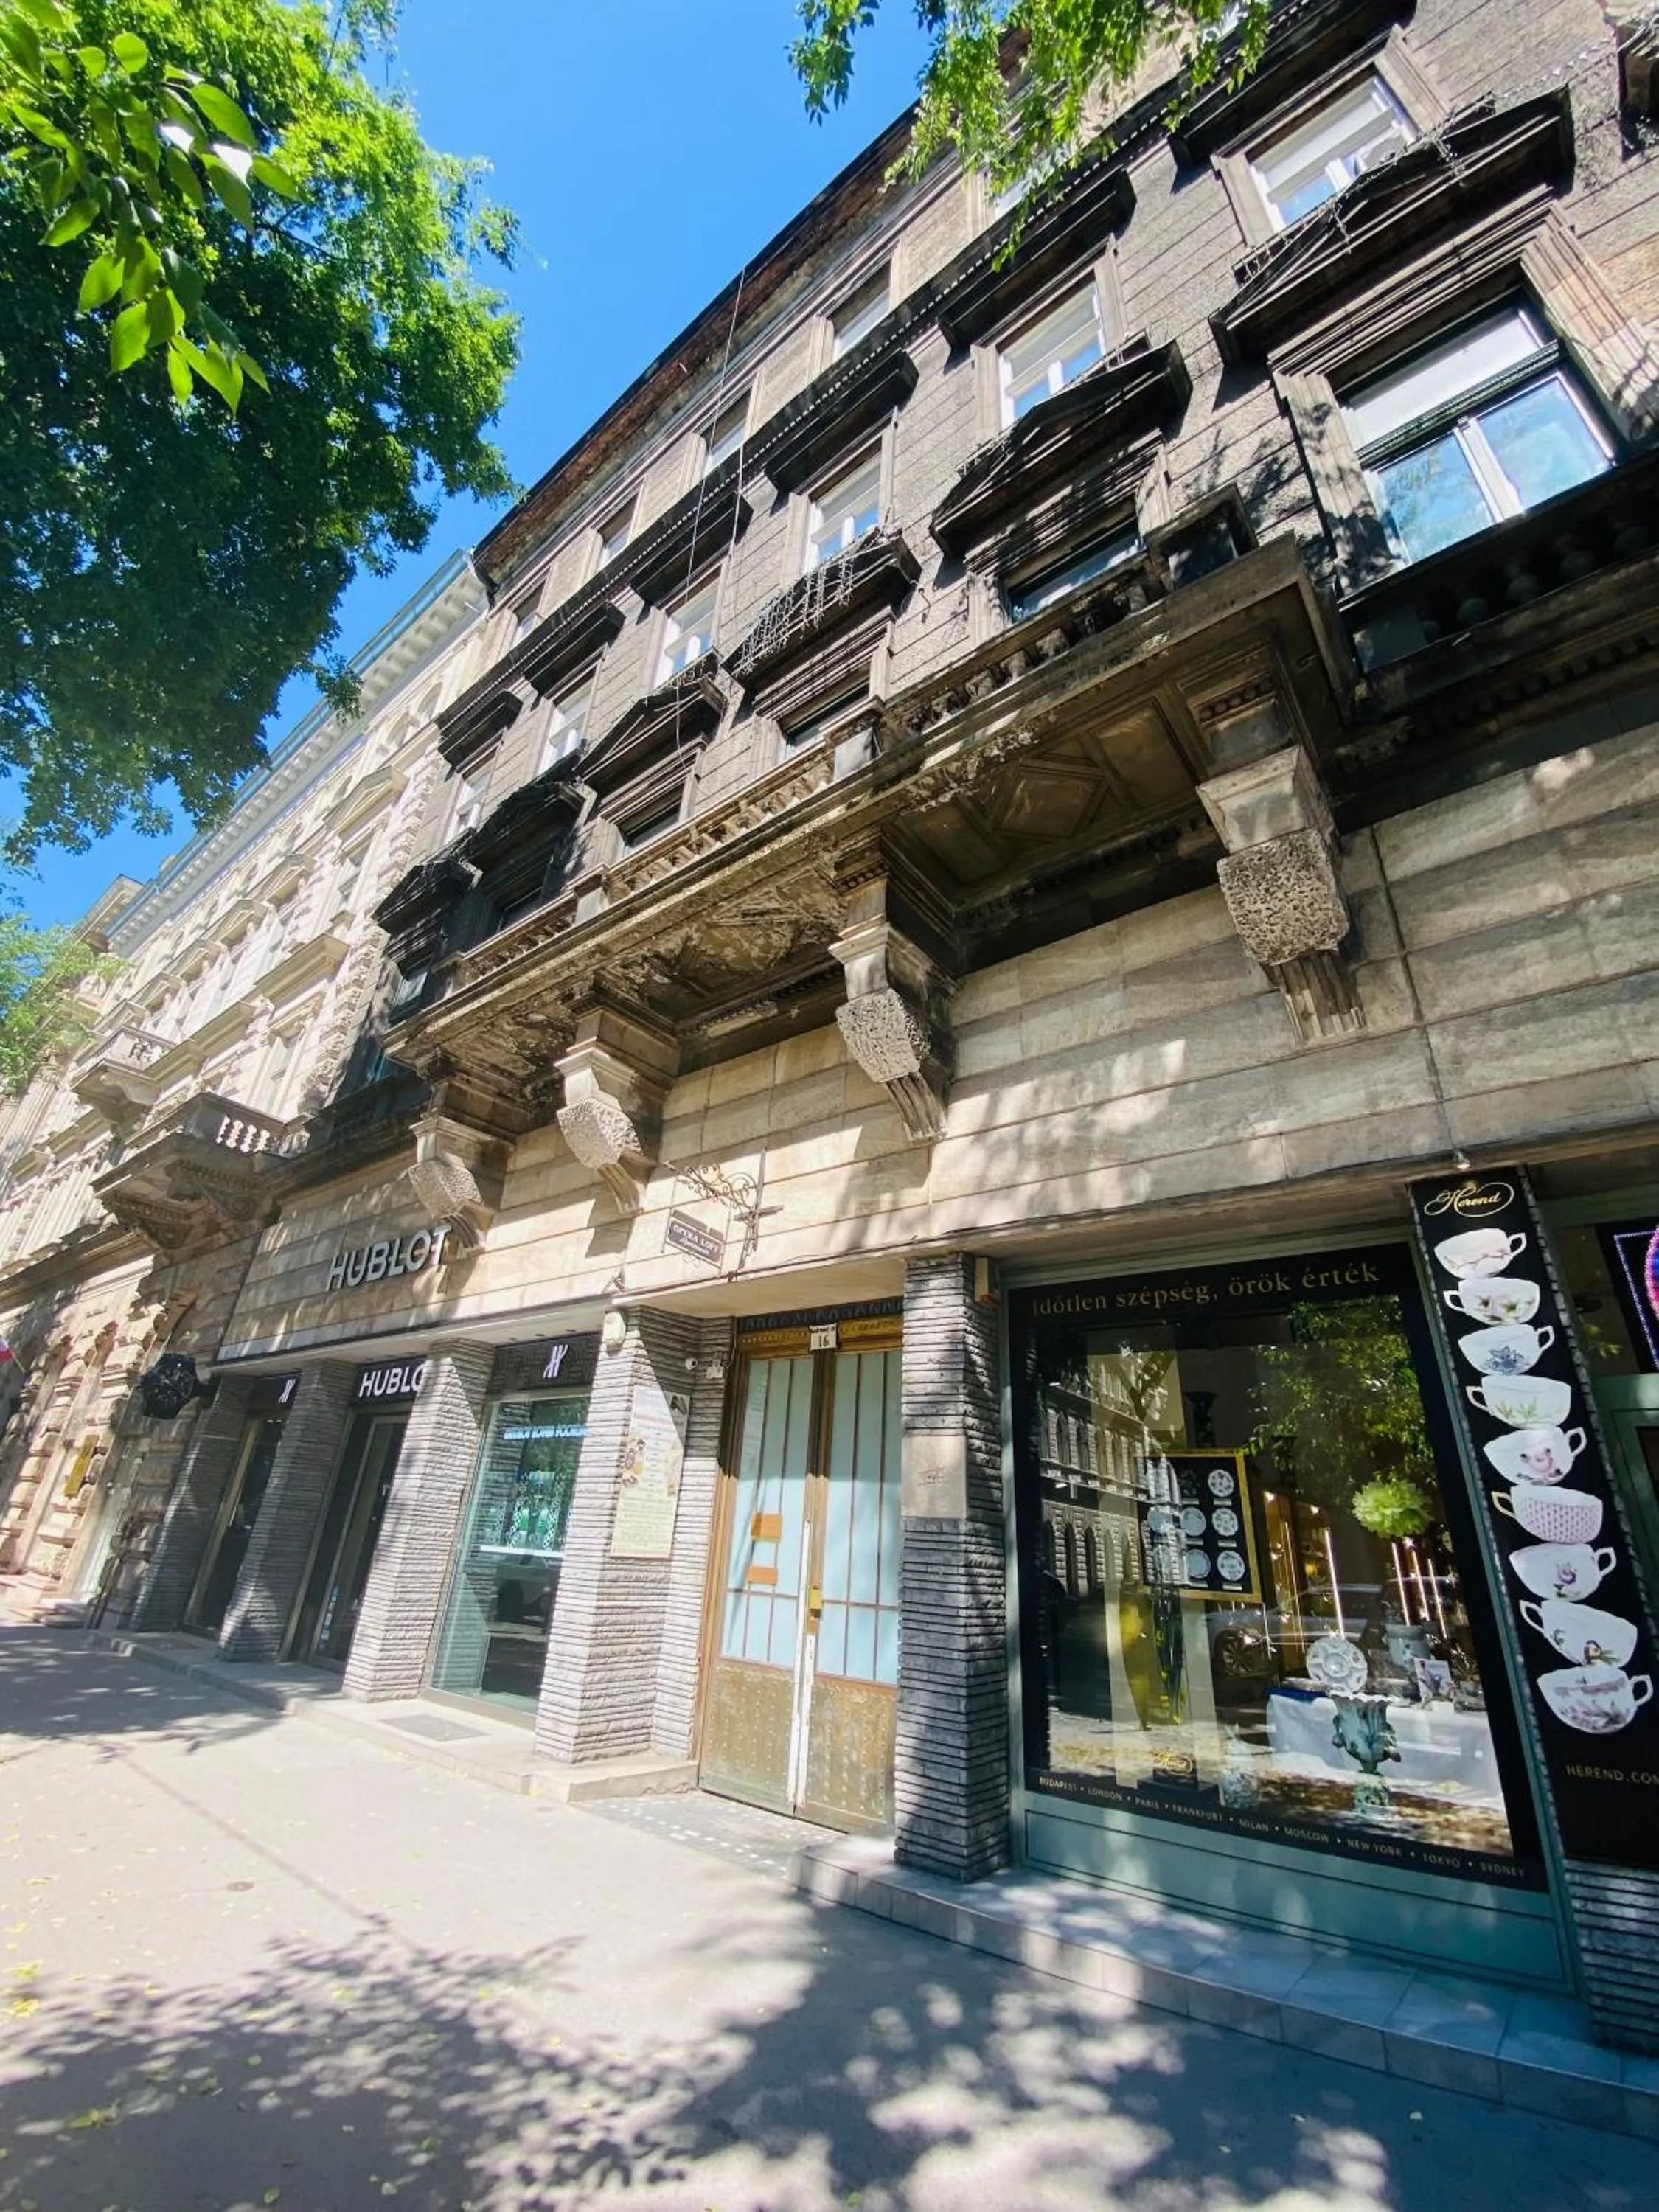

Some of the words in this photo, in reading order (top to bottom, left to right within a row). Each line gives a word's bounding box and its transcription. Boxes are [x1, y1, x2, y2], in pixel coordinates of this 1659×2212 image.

[1424, 1181, 1514, 1218] Herend
[325, 1223, 452, 1292] HUBLOT
[1229, 1271, 1291, 1296] örök
[1301, 1262, 1381, 1289] érték
[818, 1335, 830, 1347] 16
[358, 1363, 425, 1398] HUBLO
[1088, 1786, 1123, 1802] LONDON
[1135, 1796, 1160, 1811] PARIS
[1172, 1804, 1223, 1823] FRANKFURT
[1239, 1818, 1270, 1833] MILAN
[1284, 1826, 1329, 1844] MOSCOW
[1346, 1839, 1370, 1851] NEW
[1374, 1844, 1402, 1857] YORK
[1423, 1852, 1461, 1869] TOKYO
[1480, 1860, 1526, 1879] SYDNEY
